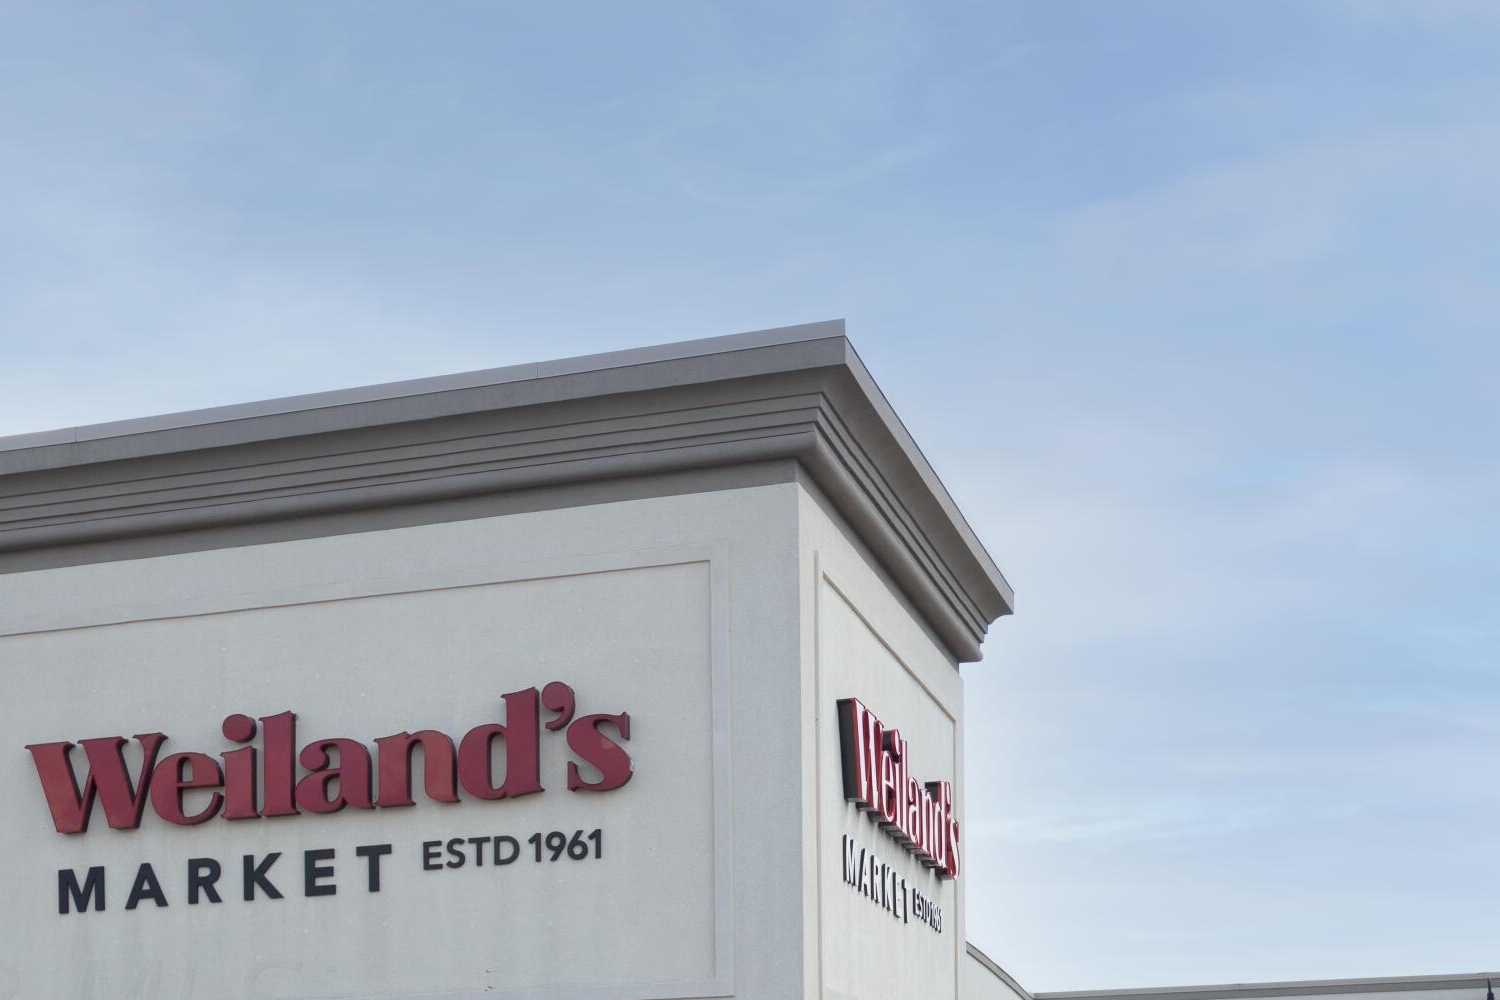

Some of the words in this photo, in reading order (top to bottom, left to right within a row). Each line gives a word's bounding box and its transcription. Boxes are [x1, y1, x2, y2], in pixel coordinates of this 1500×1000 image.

[25, 681, 634, 834] Weiland's
[837, 697, 960, 881] Weiland's
[57, 844, 392, 914] MARKET
[422, 835, 520, 870] ESTD
[527, 828, 603, 863] 1961
[842, 833, 909, 924] MARKET
